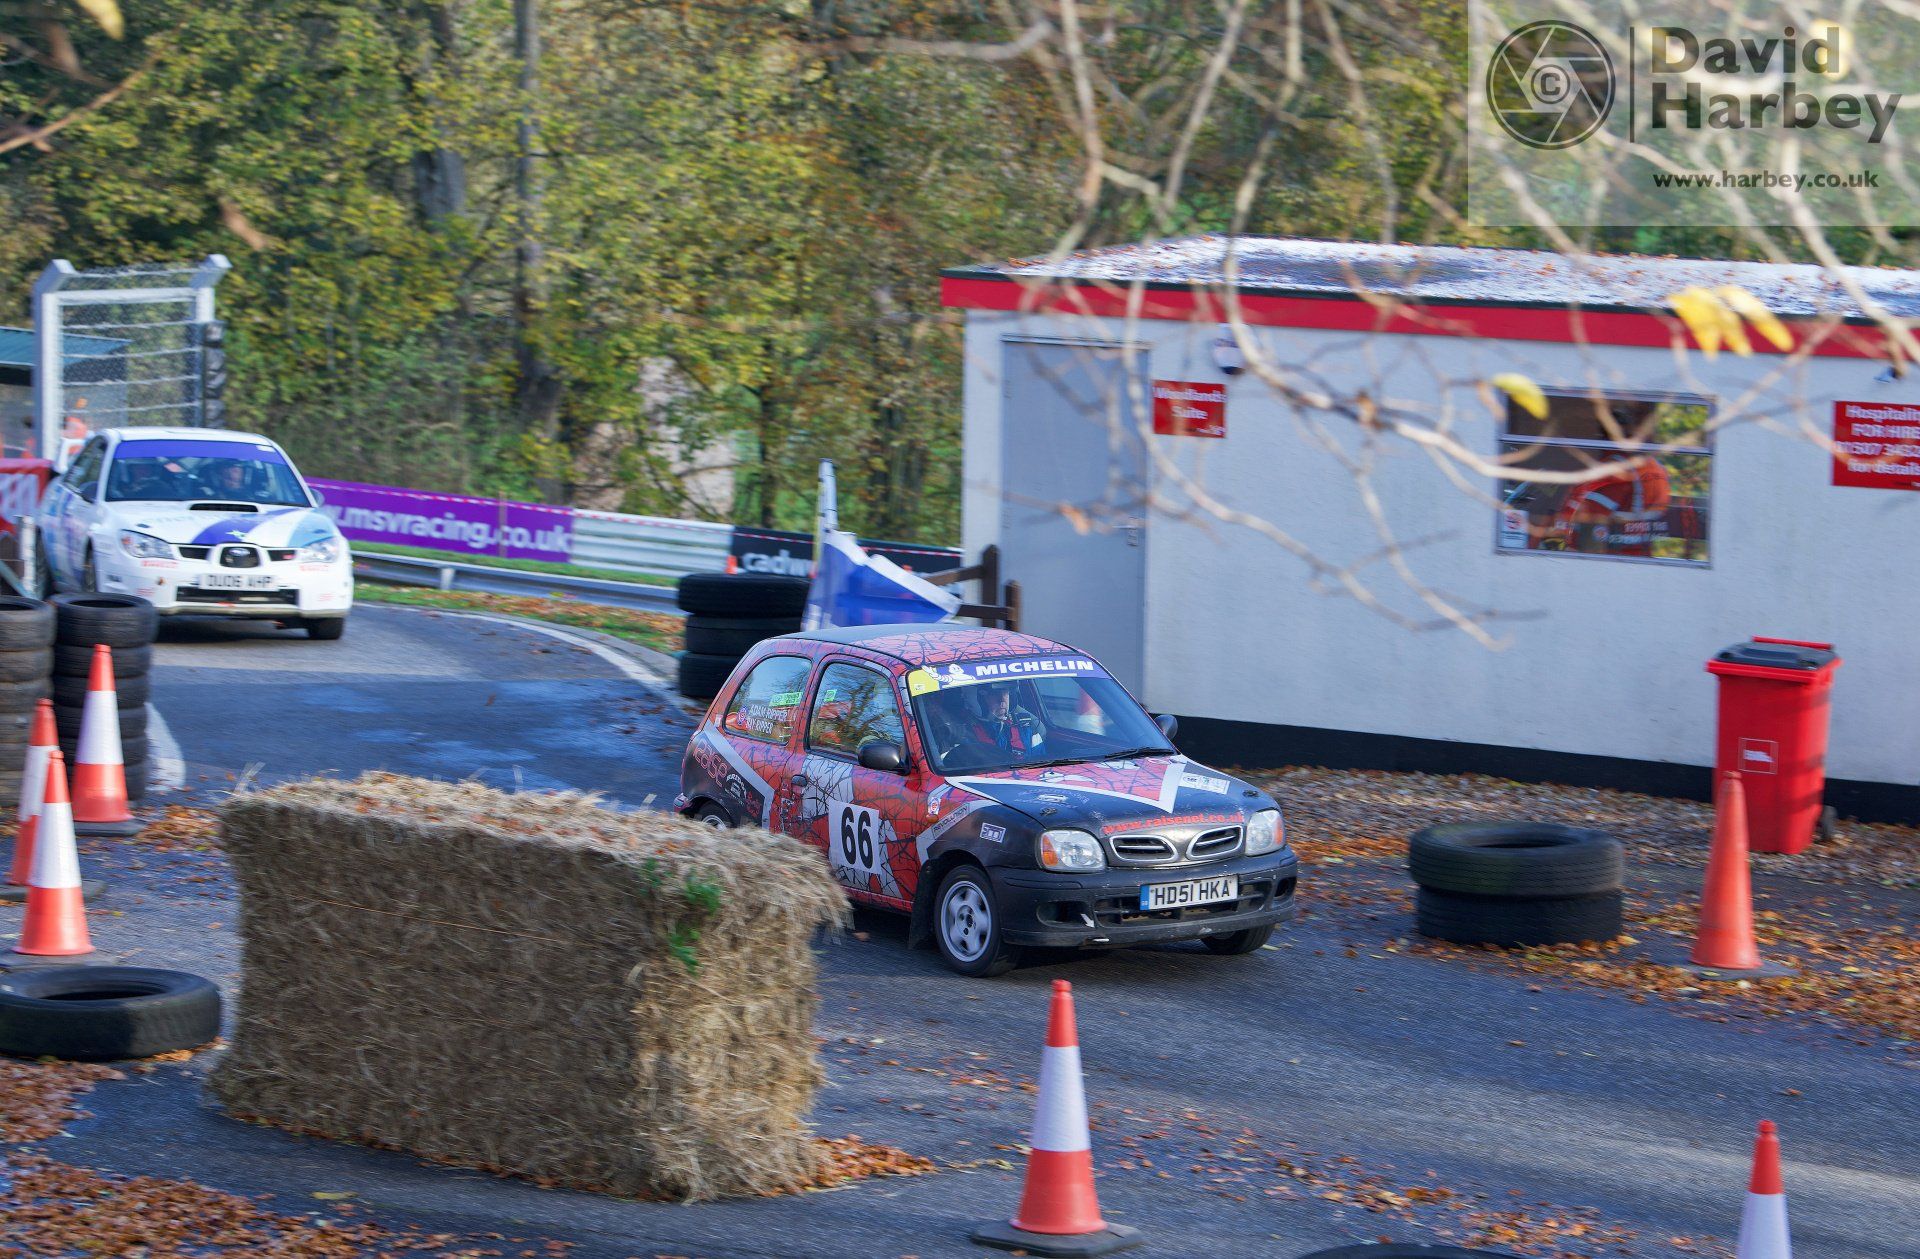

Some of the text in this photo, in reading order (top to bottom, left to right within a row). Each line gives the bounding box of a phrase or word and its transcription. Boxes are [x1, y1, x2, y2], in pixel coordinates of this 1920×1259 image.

[1171, 405, 1208, 419] Suite
[1846, 404, 1920, 422] Hospitalit
[1851, 423, 1884, 437] FOR
[975, 660, 1094, 676] MICHELIN
[1103, 811, 1244, 835] www.raisenet.co.uk
[841, 806, 873, 869] 66
[1154, 879, 1230, 905] HD51 HKA
